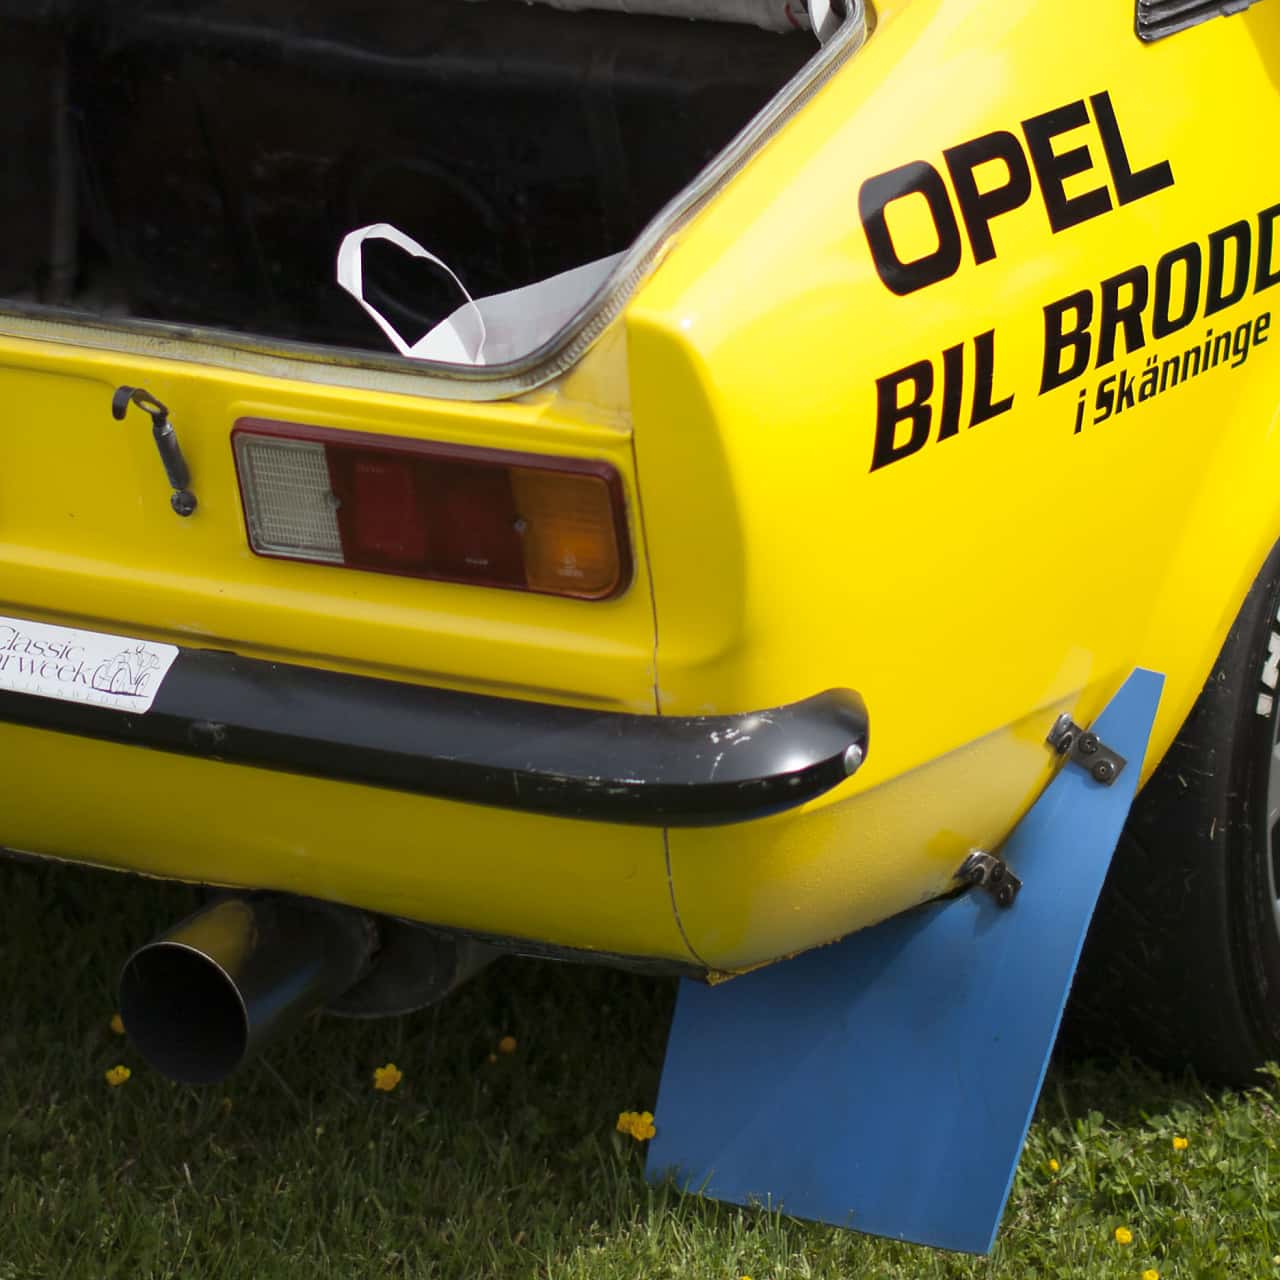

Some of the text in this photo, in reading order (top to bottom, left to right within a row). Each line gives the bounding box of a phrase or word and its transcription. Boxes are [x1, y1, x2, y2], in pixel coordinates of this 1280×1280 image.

[858, 90, 1174, 296] OPEL
[869, 328, 1014, 473] BIL
[1073, 312, 1271, 435] i Skänninge
